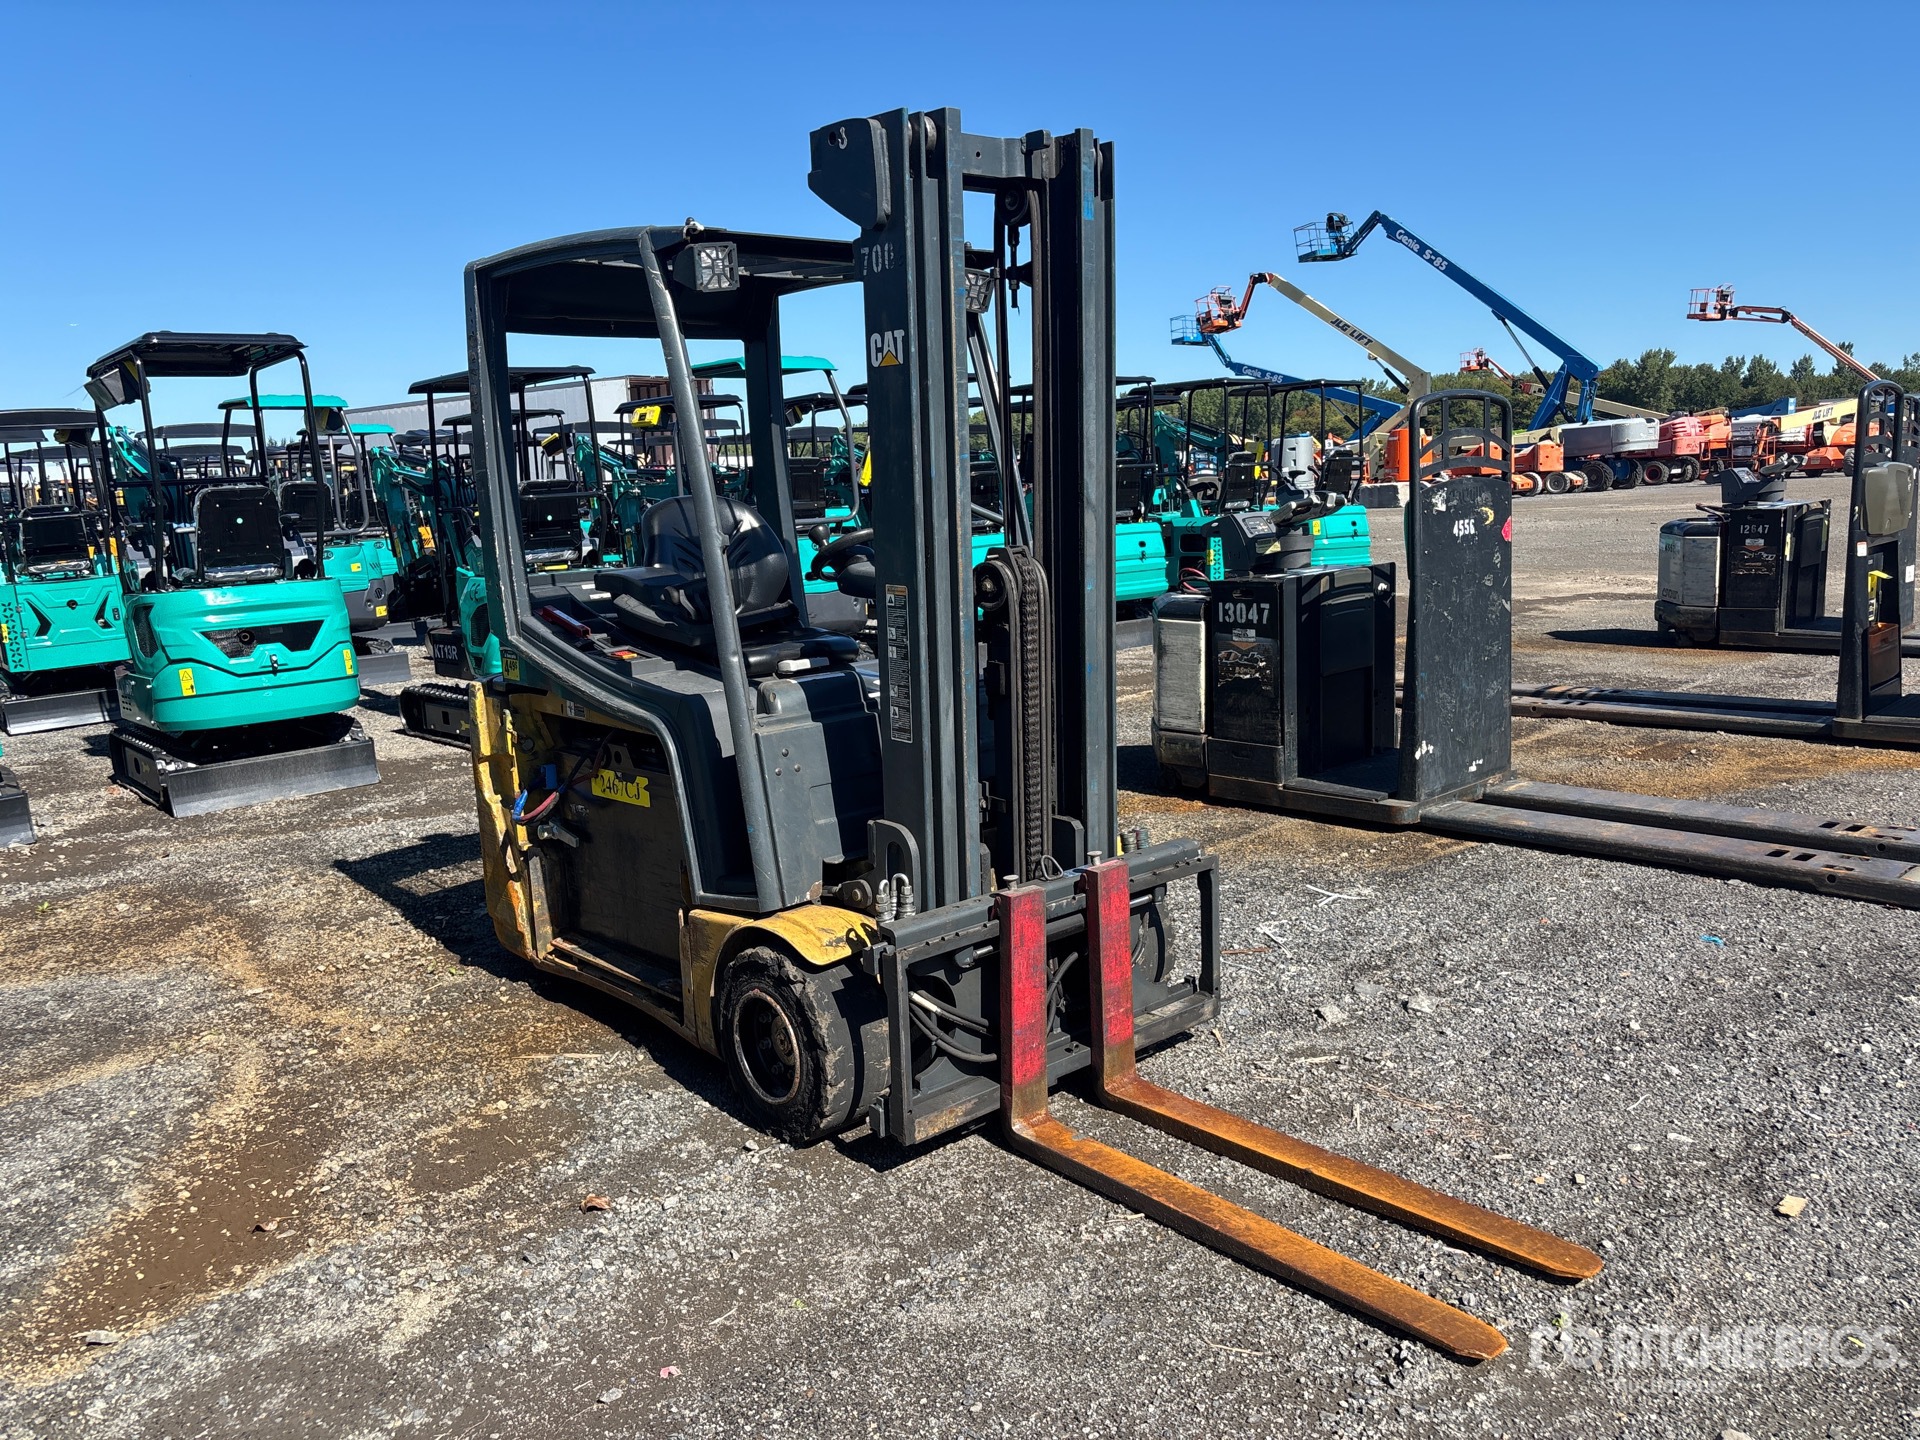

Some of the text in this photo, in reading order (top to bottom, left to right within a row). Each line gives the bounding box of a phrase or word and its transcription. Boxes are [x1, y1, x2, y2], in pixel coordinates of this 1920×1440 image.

[1395, 229, 1449, 271] Genie S-85
[1330, 318, 1374, 346] JLG LIFT
[870, 329, 905, 368] CAT
[1242, 365, 1284, 384] Genie S-85
[1740, 524, 1770, 535] 12647
[1218, 602, 1270, 625] 13047
[434, 643, 459, 661] KT13R
